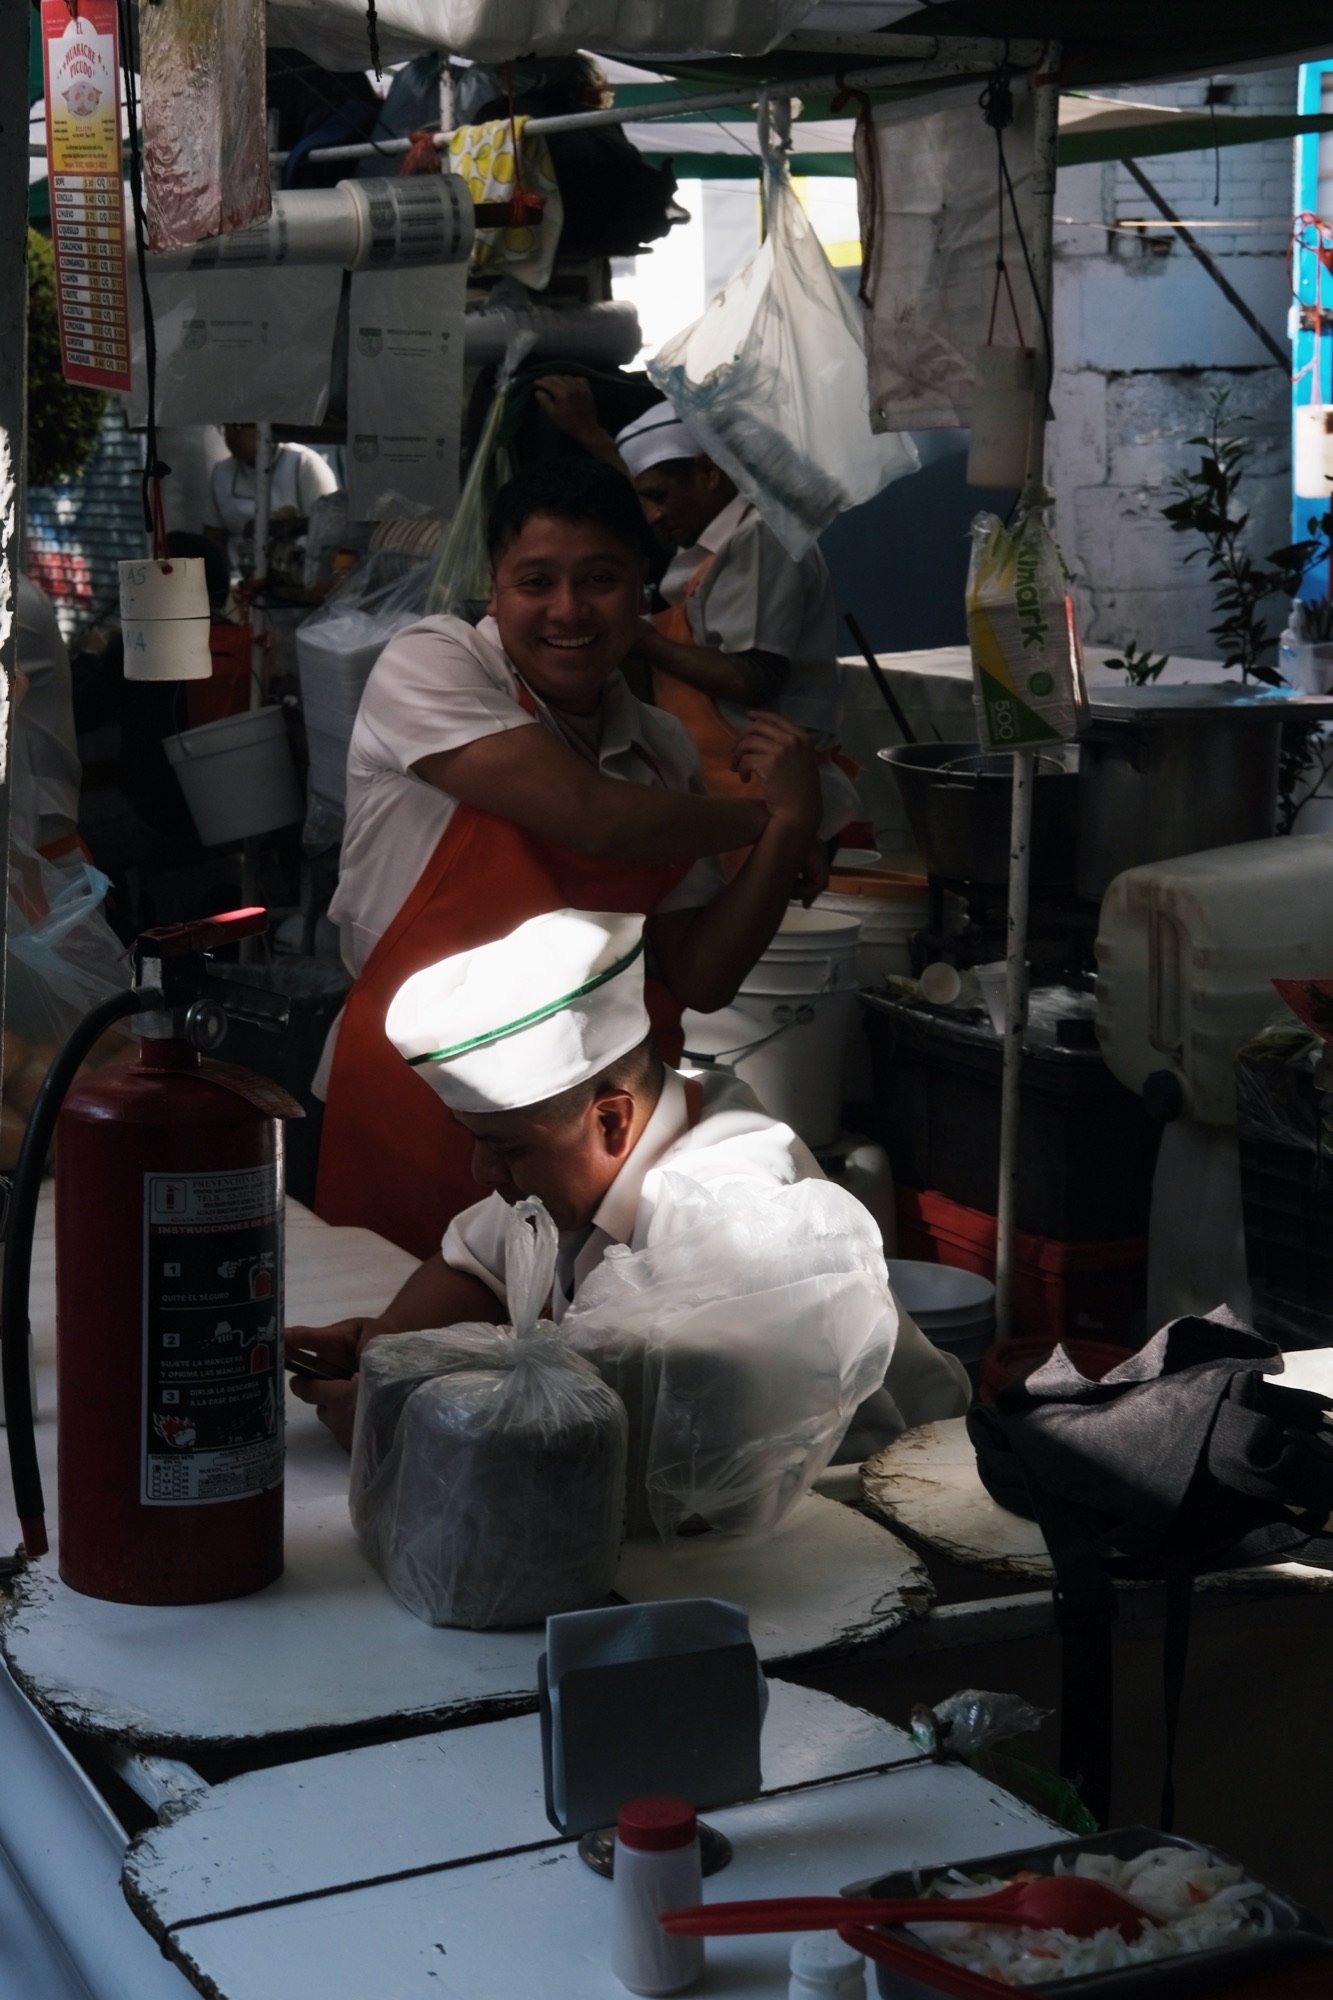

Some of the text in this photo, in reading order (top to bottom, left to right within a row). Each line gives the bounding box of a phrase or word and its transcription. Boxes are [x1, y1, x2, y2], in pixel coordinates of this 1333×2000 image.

[75, 21, 83, 34] EL
[65, 43, 96, 65] HUARACHE
[70, 61, 93, 79] PICUDO
[995, 700, 1014, 739] 500
[158, 1221, 249, 1234] INSTRUCCIONES
[162, 1294, 188, 1303] QUITE
